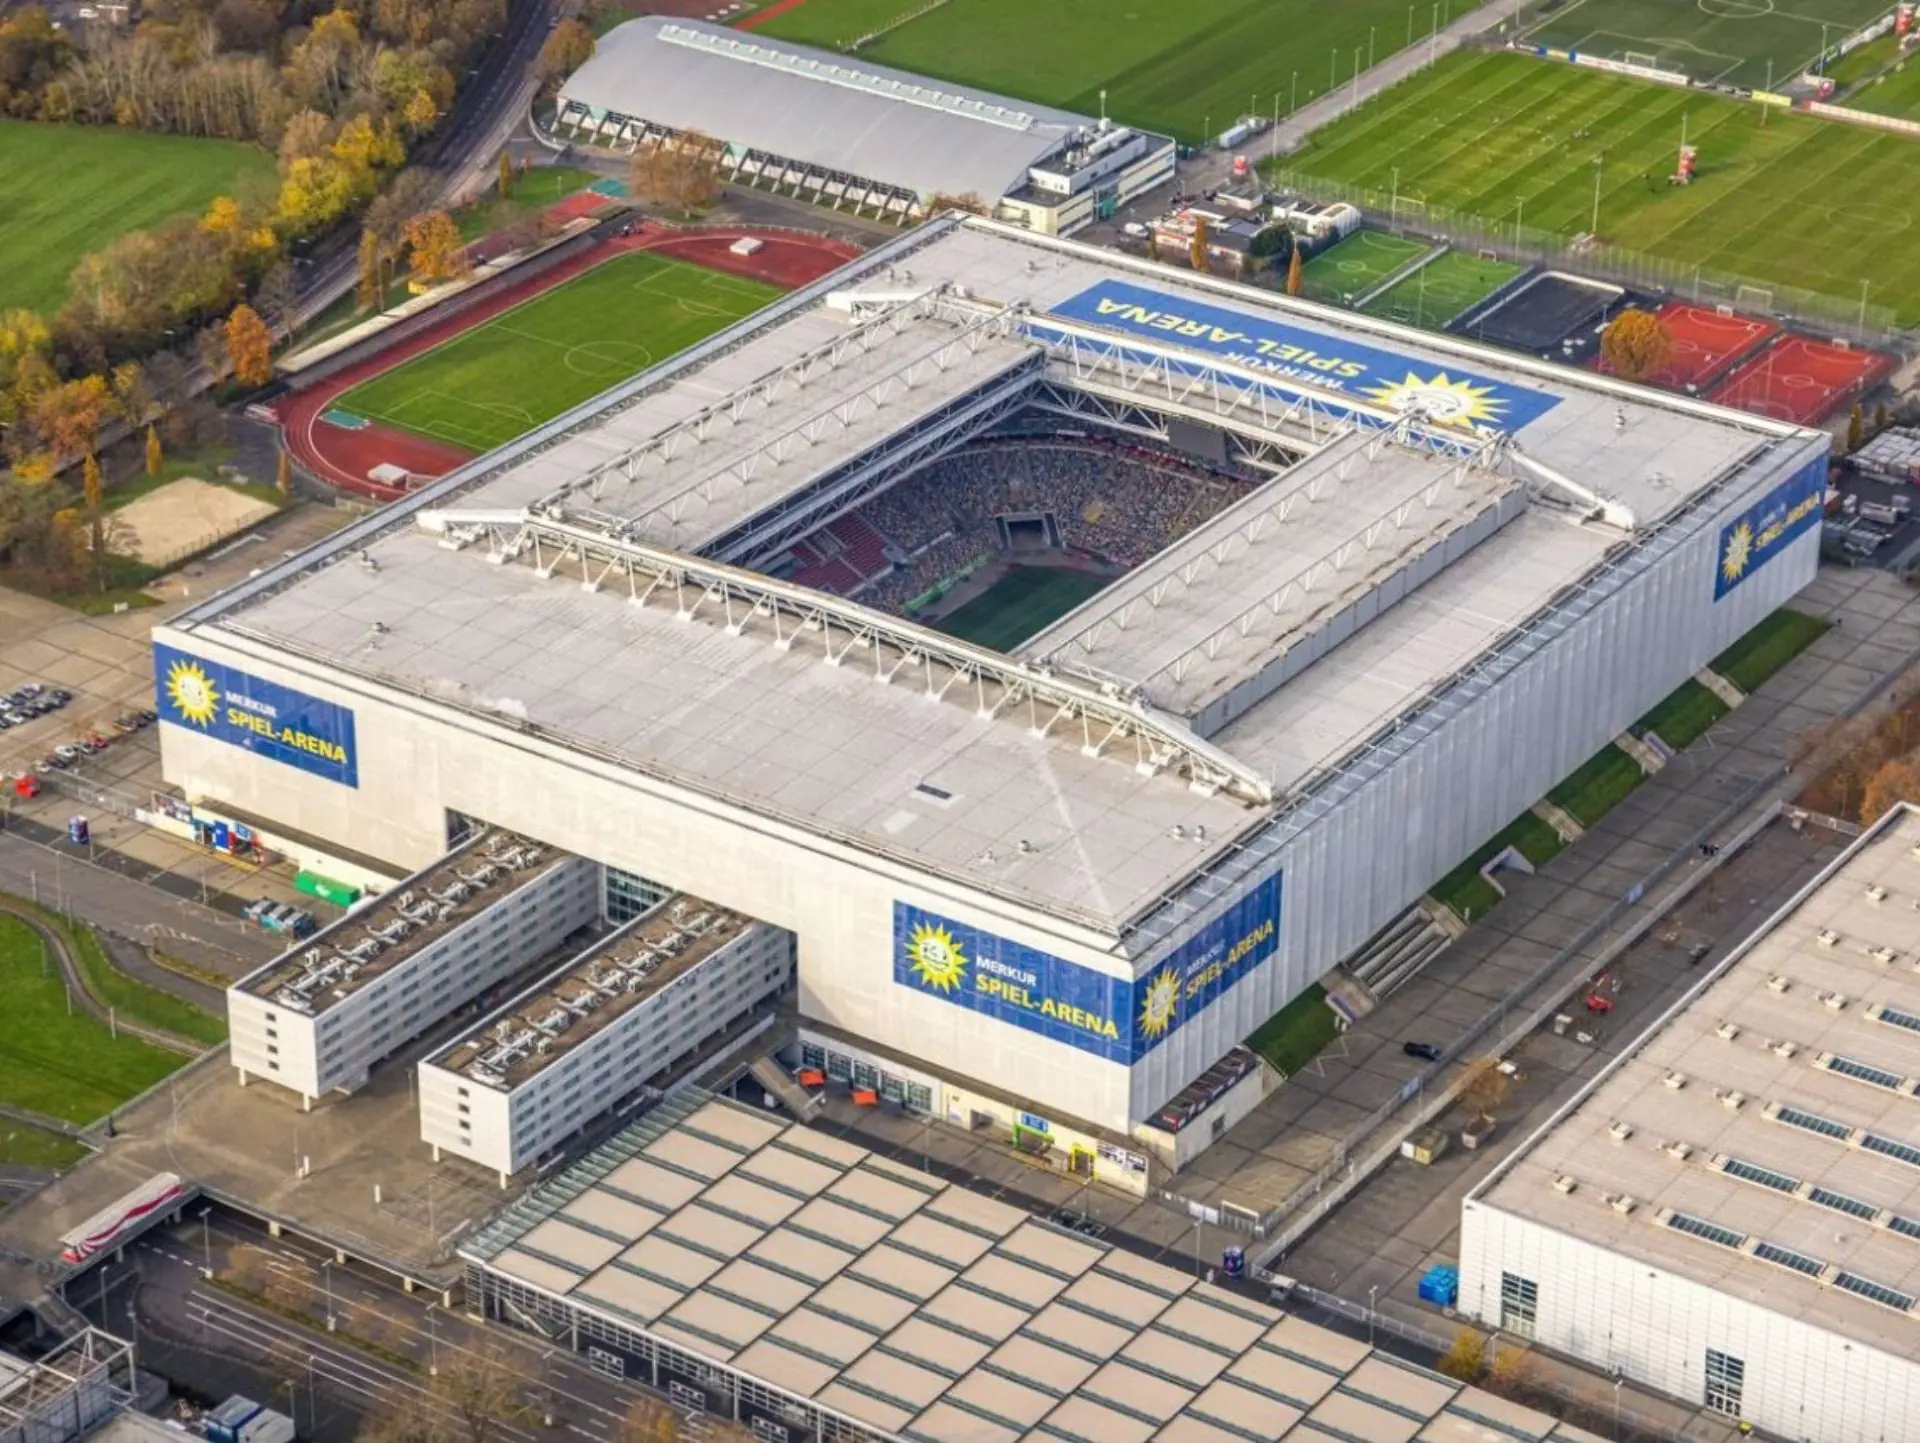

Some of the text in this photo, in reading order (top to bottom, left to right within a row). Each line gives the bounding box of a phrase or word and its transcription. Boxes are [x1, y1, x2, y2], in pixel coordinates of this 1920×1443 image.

[1096, 297, 1368, 378] SPIEL-ARENA
[225, 691, 277, 718] MERKUR
[228, 708, 346, 763] SPIEL-ARENA
[976, 955, 1036, 987] MERKUR
[1186, 919, 1274, 999] SPIEL-ARENA
[975, 974, 1119, 1040] SPIEL-ARENA
